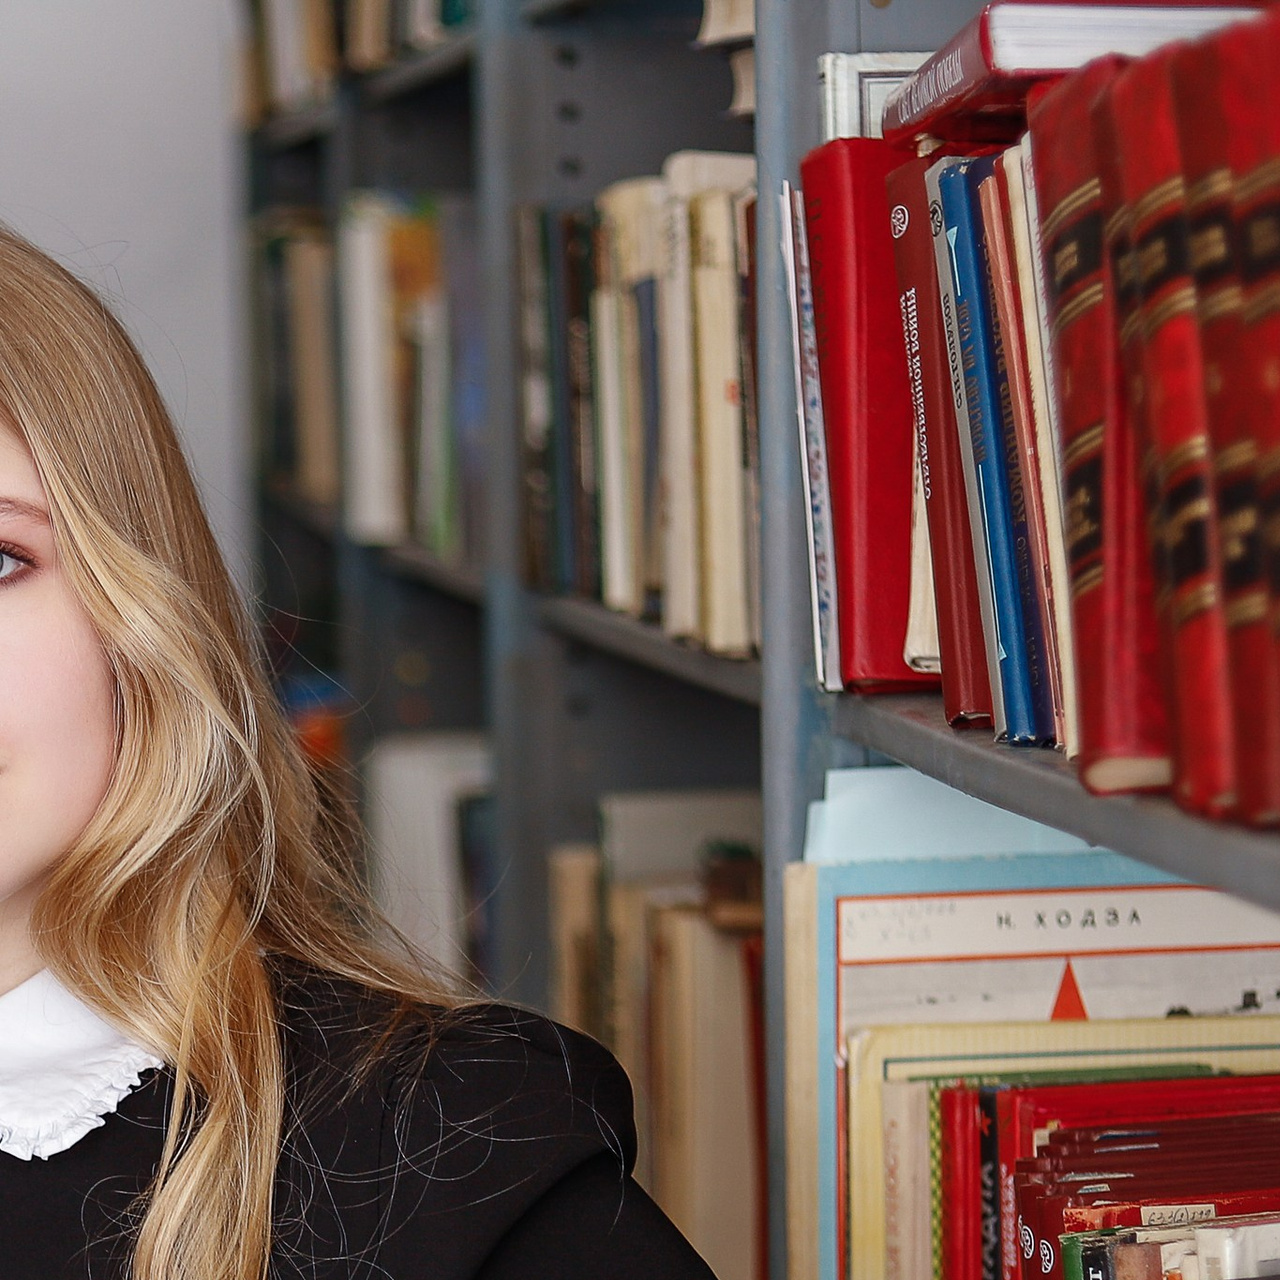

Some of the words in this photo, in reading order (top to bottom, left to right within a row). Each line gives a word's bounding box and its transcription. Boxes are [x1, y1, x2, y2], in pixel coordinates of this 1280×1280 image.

[906, 287, 920, 353] ВОЙНЫ
[912, 355, 932, 500] ОТЕЧЕСТВЕННОЙ
[1000, 383, 1026, 527] КОМАНДИР
